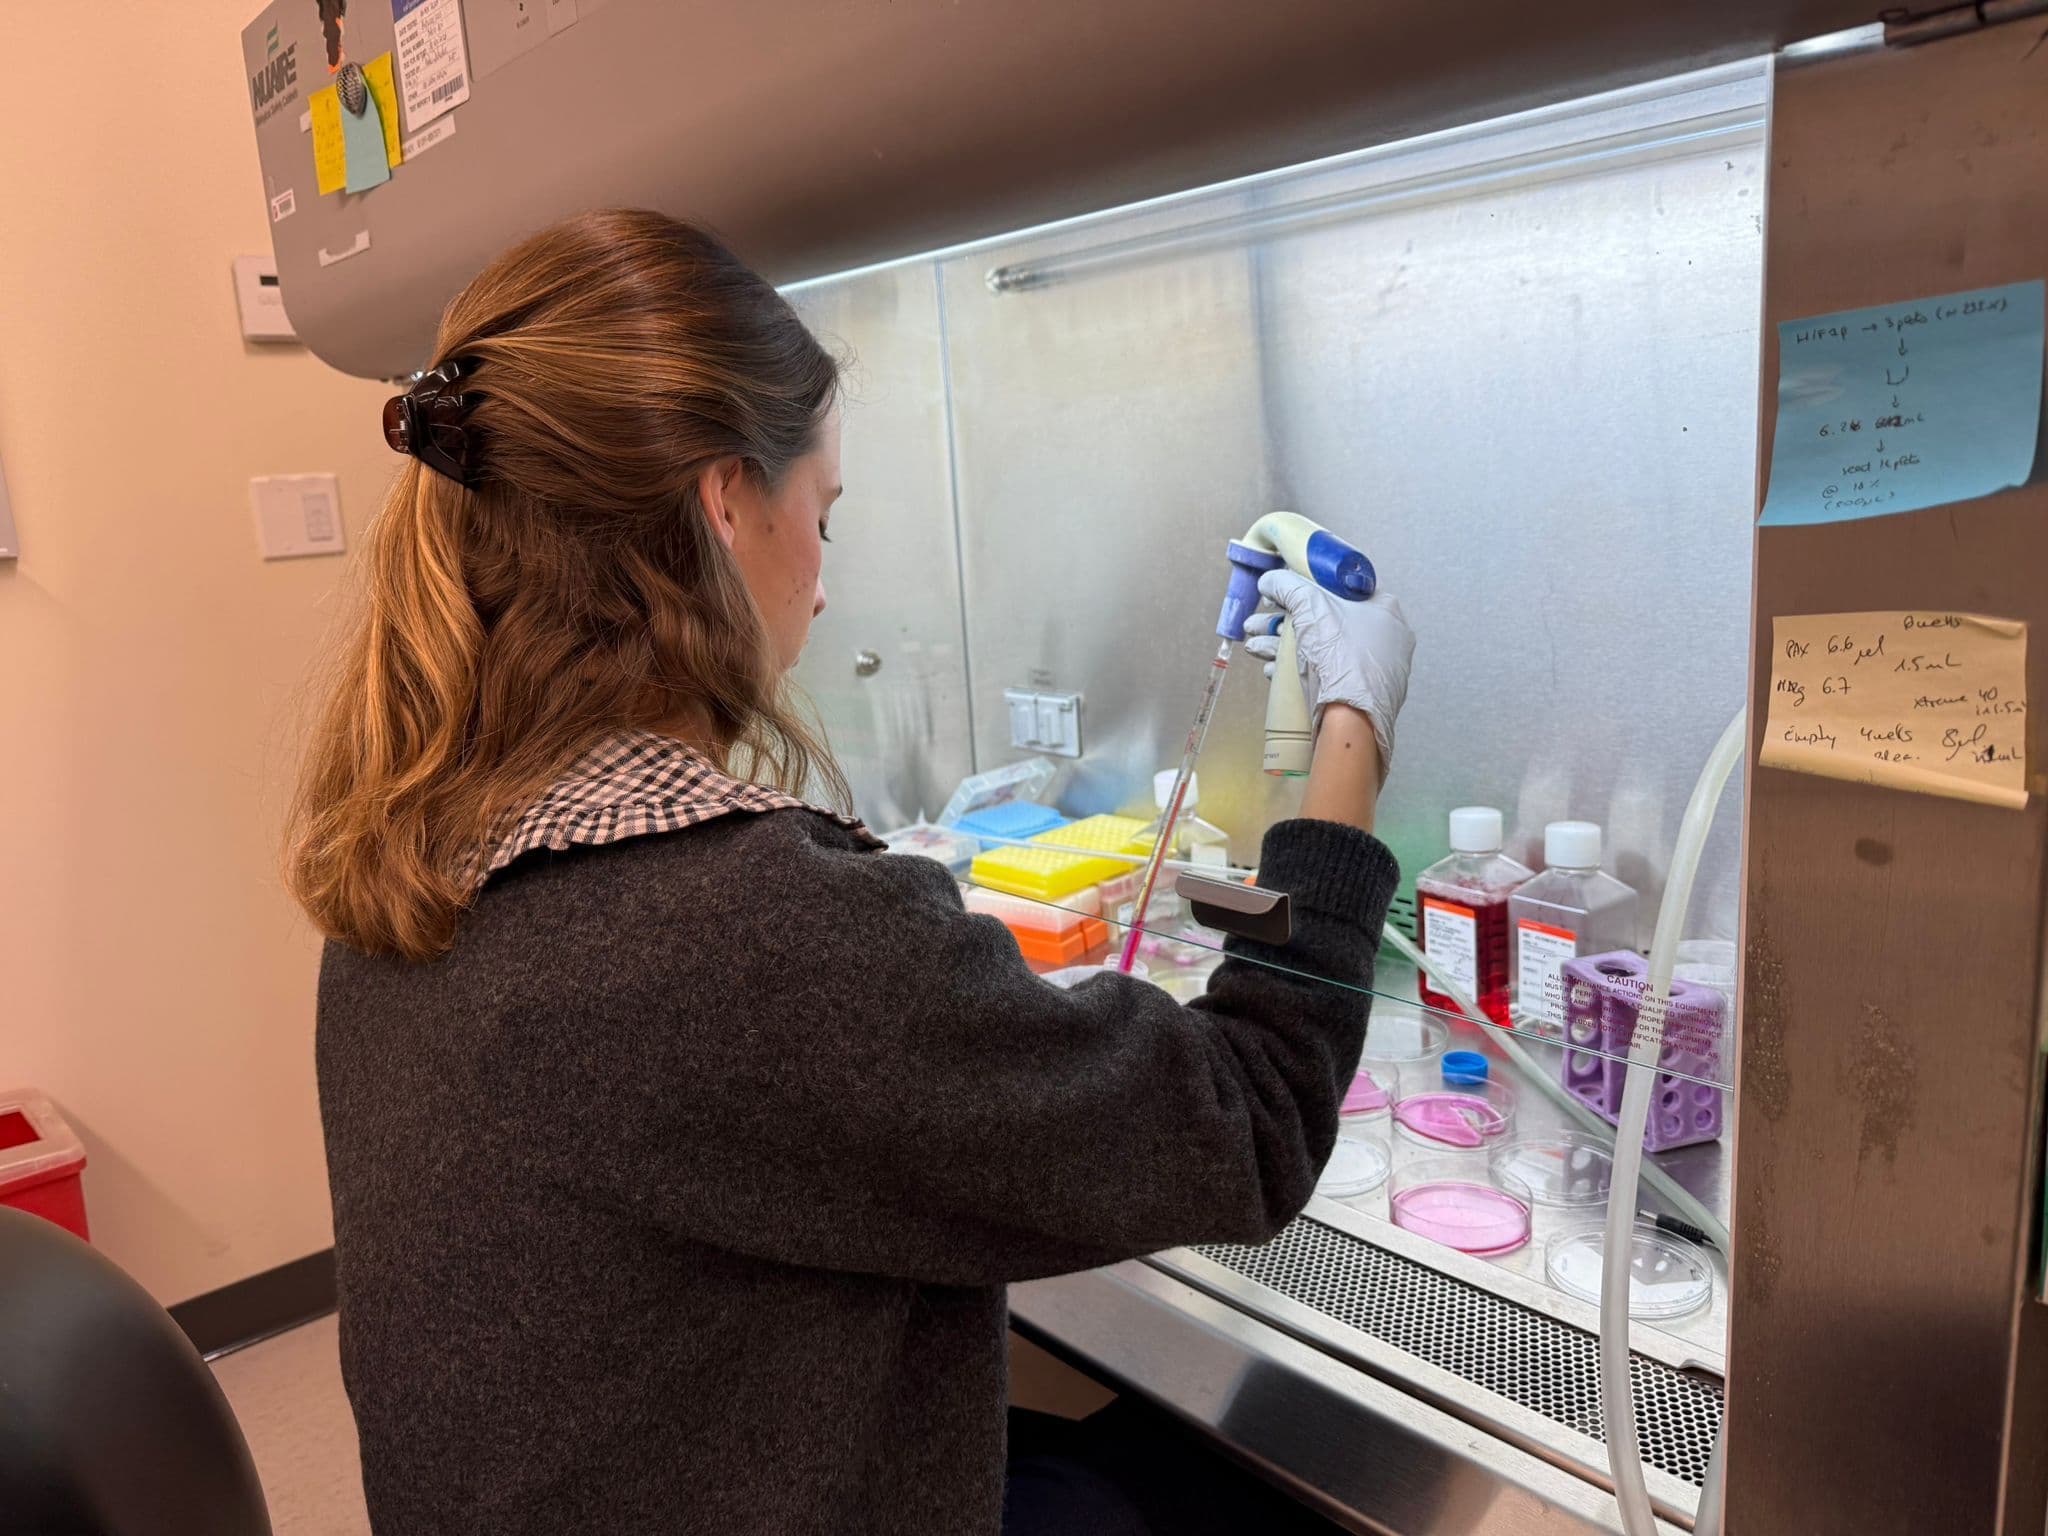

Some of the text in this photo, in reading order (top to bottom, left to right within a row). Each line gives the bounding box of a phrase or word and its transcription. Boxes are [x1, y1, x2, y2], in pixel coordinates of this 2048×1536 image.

[1822, 676, 1851, 695] 6.7
[1607, 974, 1654, 992] CAUTION
[1544, 982, 1562, 990] MUST
[1637, 1003, 1675, 1017] QUALIFIED
[1545, 991, 1560, 1000] WHO
[1548, 973, 1560, 981] ALL
[1613, 988, 1643, 1000] ACTIONS
[1644, 995, 1655, 1003] ON
[1657, 998, 1674, 1008] THIS
[1675, 1002, 1719, 1017] EQUIPMENT
